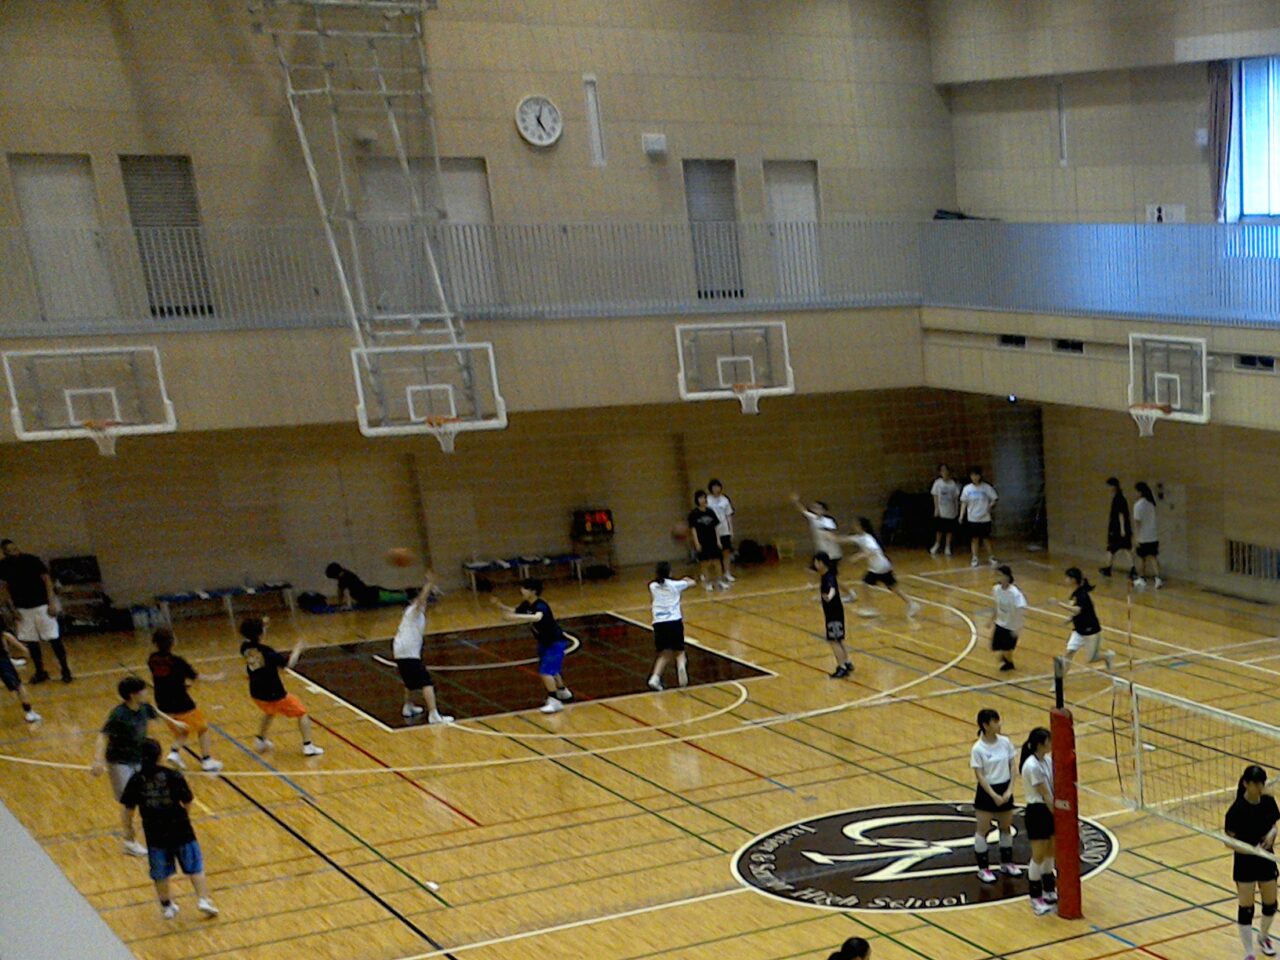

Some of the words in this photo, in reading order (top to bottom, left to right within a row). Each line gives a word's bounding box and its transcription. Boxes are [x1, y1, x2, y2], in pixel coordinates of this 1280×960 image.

[759, 824, 817, 852] Junior
[791, 887, 860, 906] High
[868, 892, 967, 908] School
